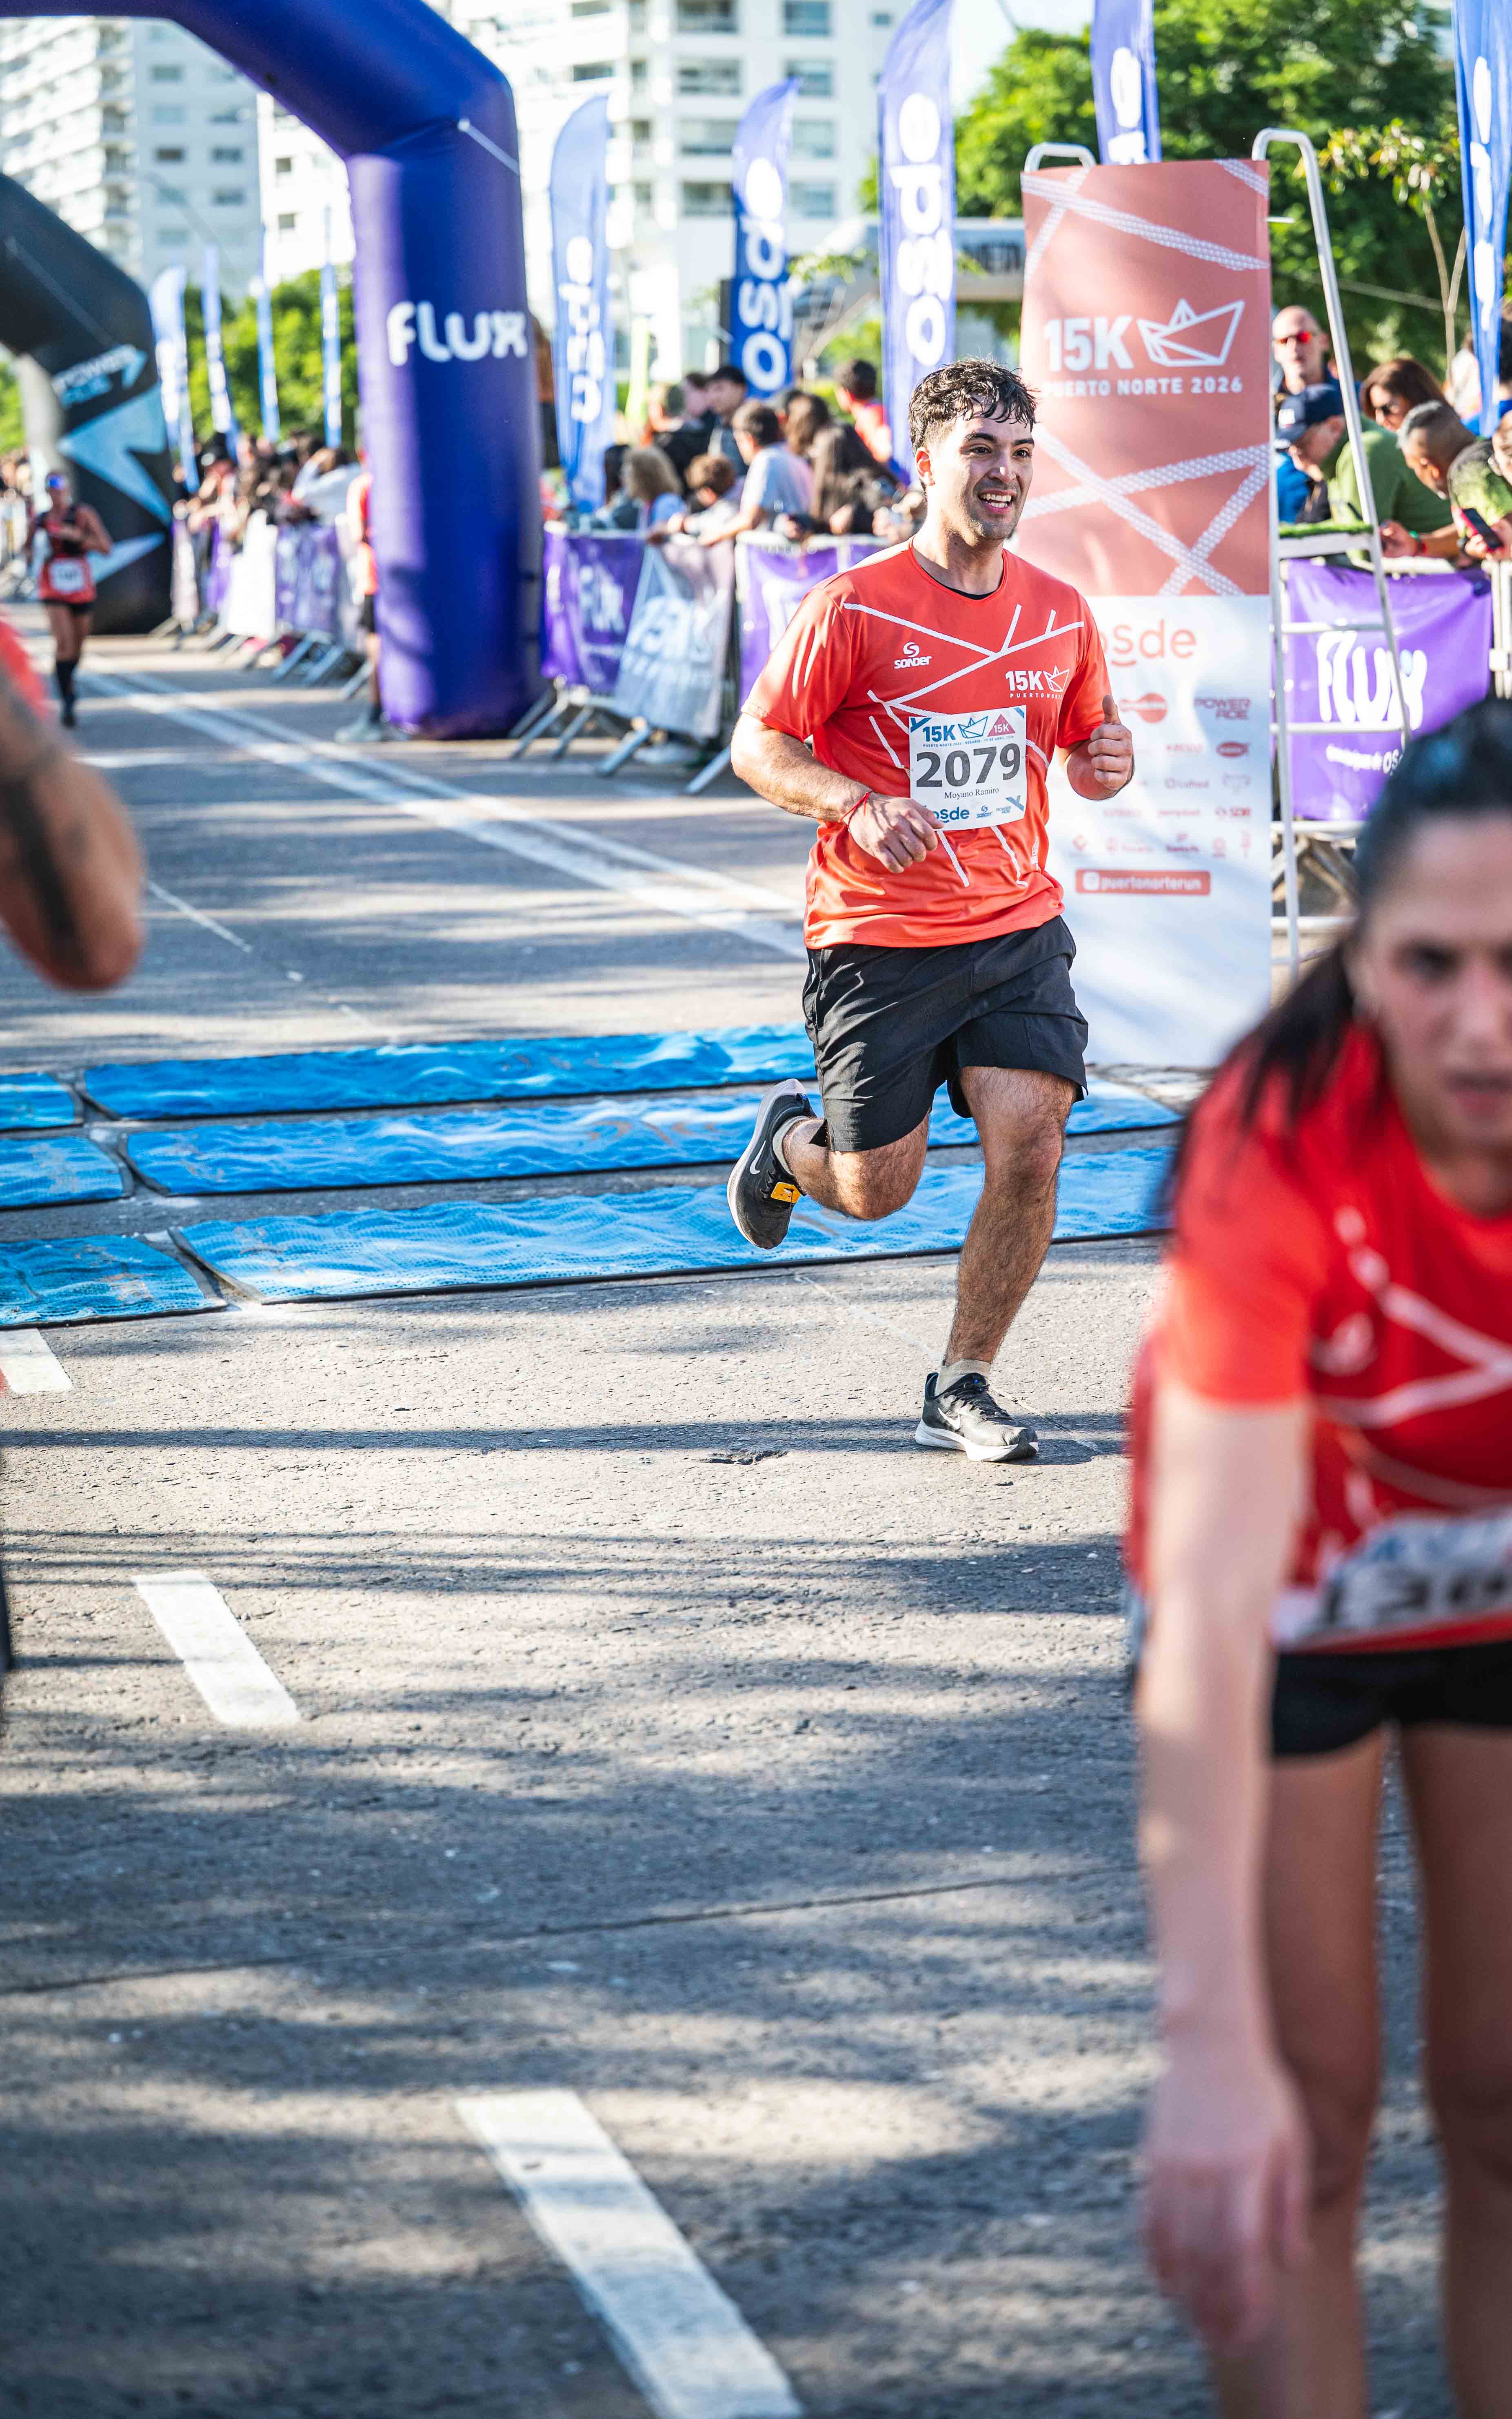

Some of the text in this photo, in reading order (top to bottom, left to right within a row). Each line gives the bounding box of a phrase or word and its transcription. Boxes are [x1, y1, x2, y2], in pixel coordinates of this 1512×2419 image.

[1044, 315, 1135, 372] 15K
[1117, 378, 1183, 395] NORTE
[1191, 376, 1243, 394] 2026
[1005, 671, 1044, 691] 15K
[923, 724, 956, 742] 15K
[993, 723, 1010, 733] 15K
[916, 743, 1021, 787] 2079
[944, 786, 999, 800] Moyano Ramiro
